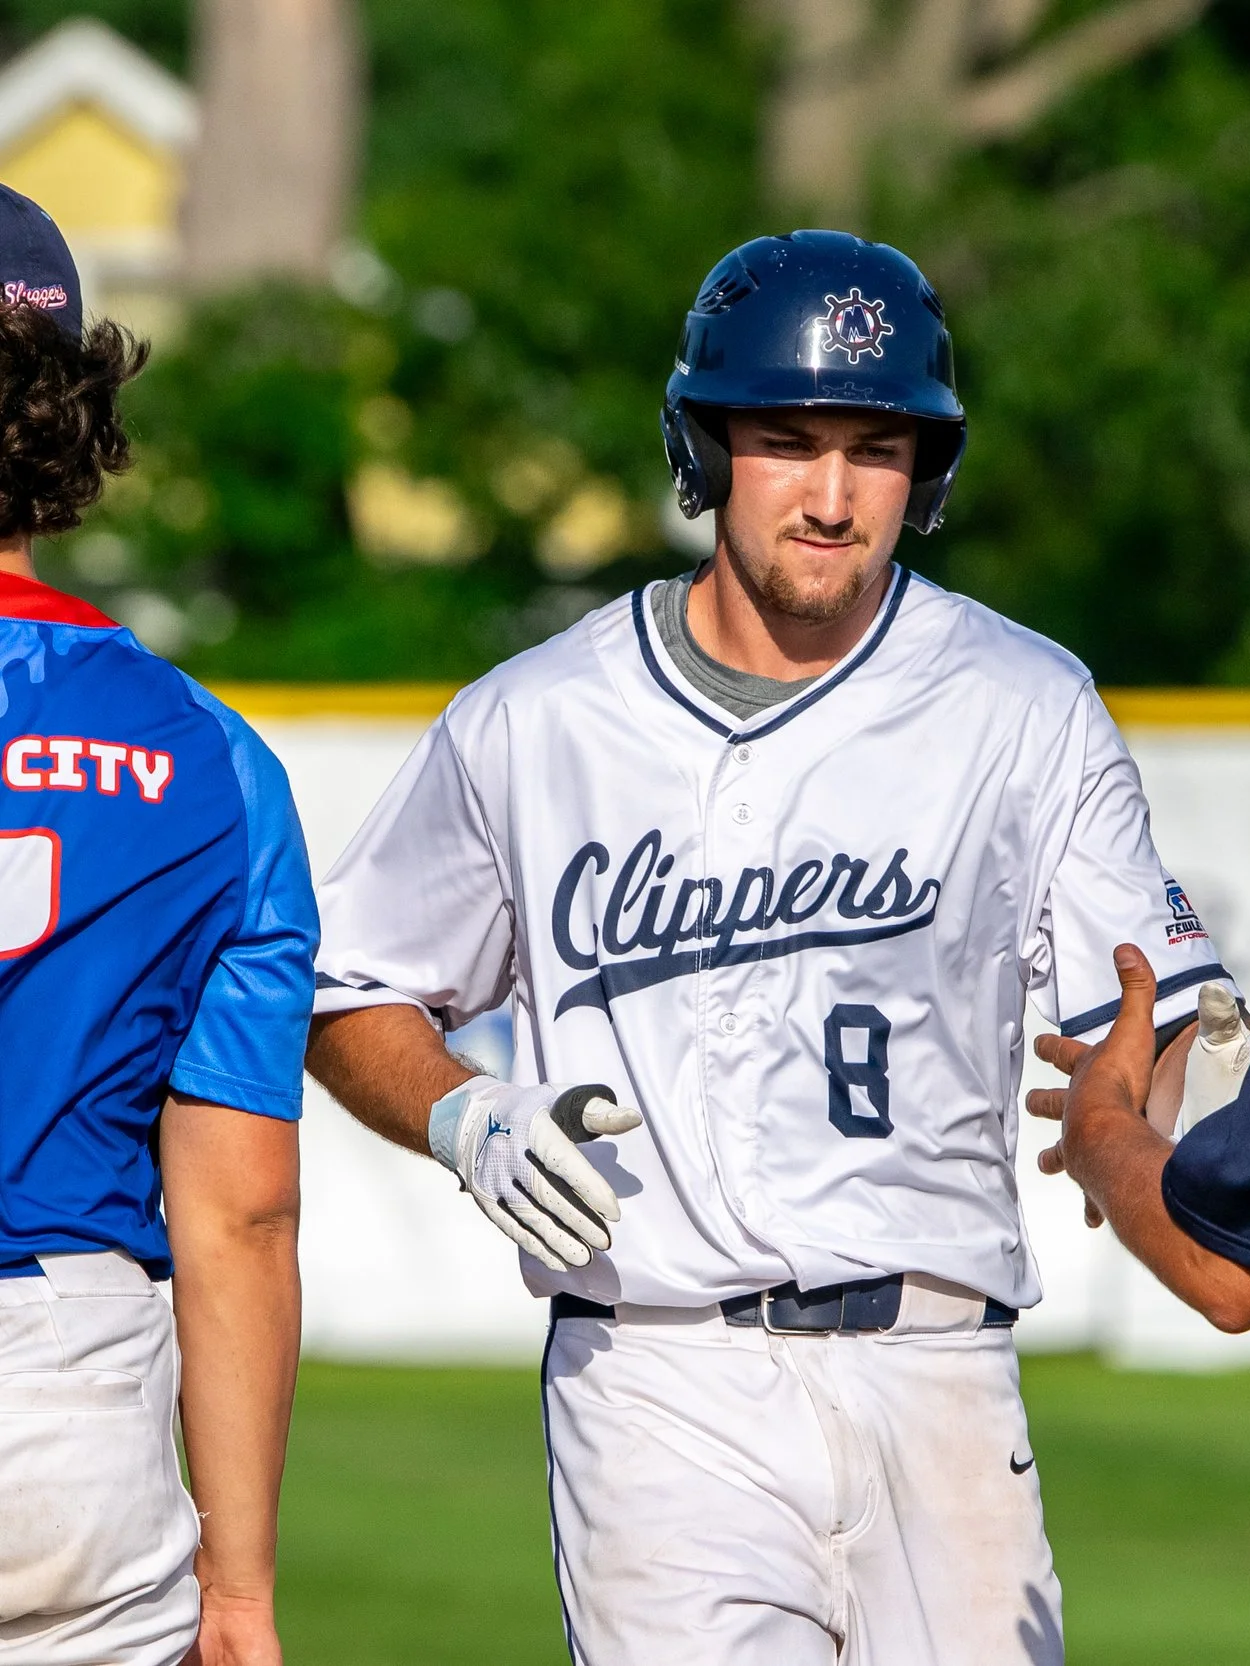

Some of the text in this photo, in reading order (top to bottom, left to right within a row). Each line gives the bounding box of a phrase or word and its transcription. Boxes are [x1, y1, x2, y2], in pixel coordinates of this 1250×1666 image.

[2, 734, 174, 804] CITY
[552, 828, 941, 988] Clippers
[823, 1003, 895, 1139] 8
